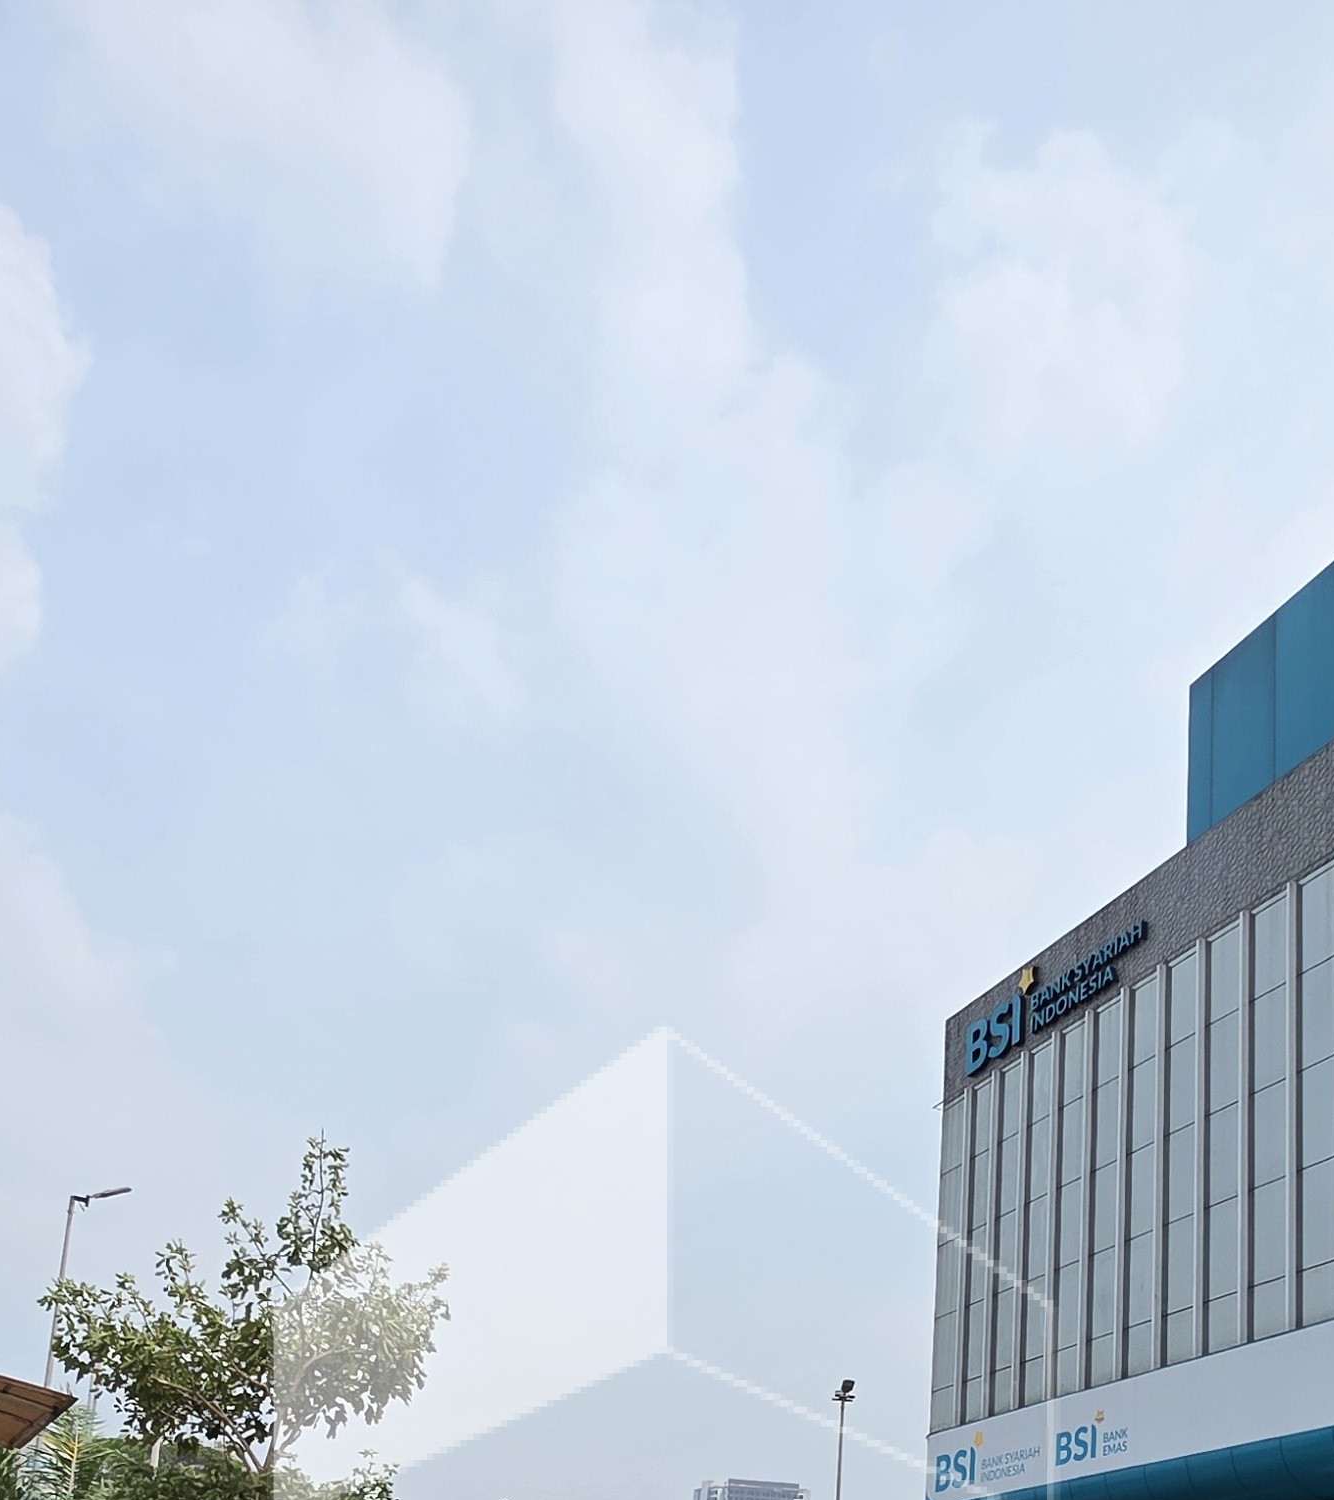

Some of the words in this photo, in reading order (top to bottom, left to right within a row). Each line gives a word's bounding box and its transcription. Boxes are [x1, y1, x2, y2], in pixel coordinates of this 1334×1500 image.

[1029, 971, 1072, 1012] BANK
[1074, 919, 1147, 982] SYARIAH
[1029, 965, 1116, 1034] INDONESIA
[967, 992, 1024, 1076] BSI
[1055, 1424, 1098, 1467] BSI
[1102, 1441, 1129, 1457] EMAS
[1103, 1427, 1129, 1444] BANK
[935, 1446, 978, 1493] BSI
[980, 1463, 1026, 1483] INDONESIA
[981, 1455, 1004, 1471] BANK
[1004, 1446, 1041, 1464] SYARIAH
